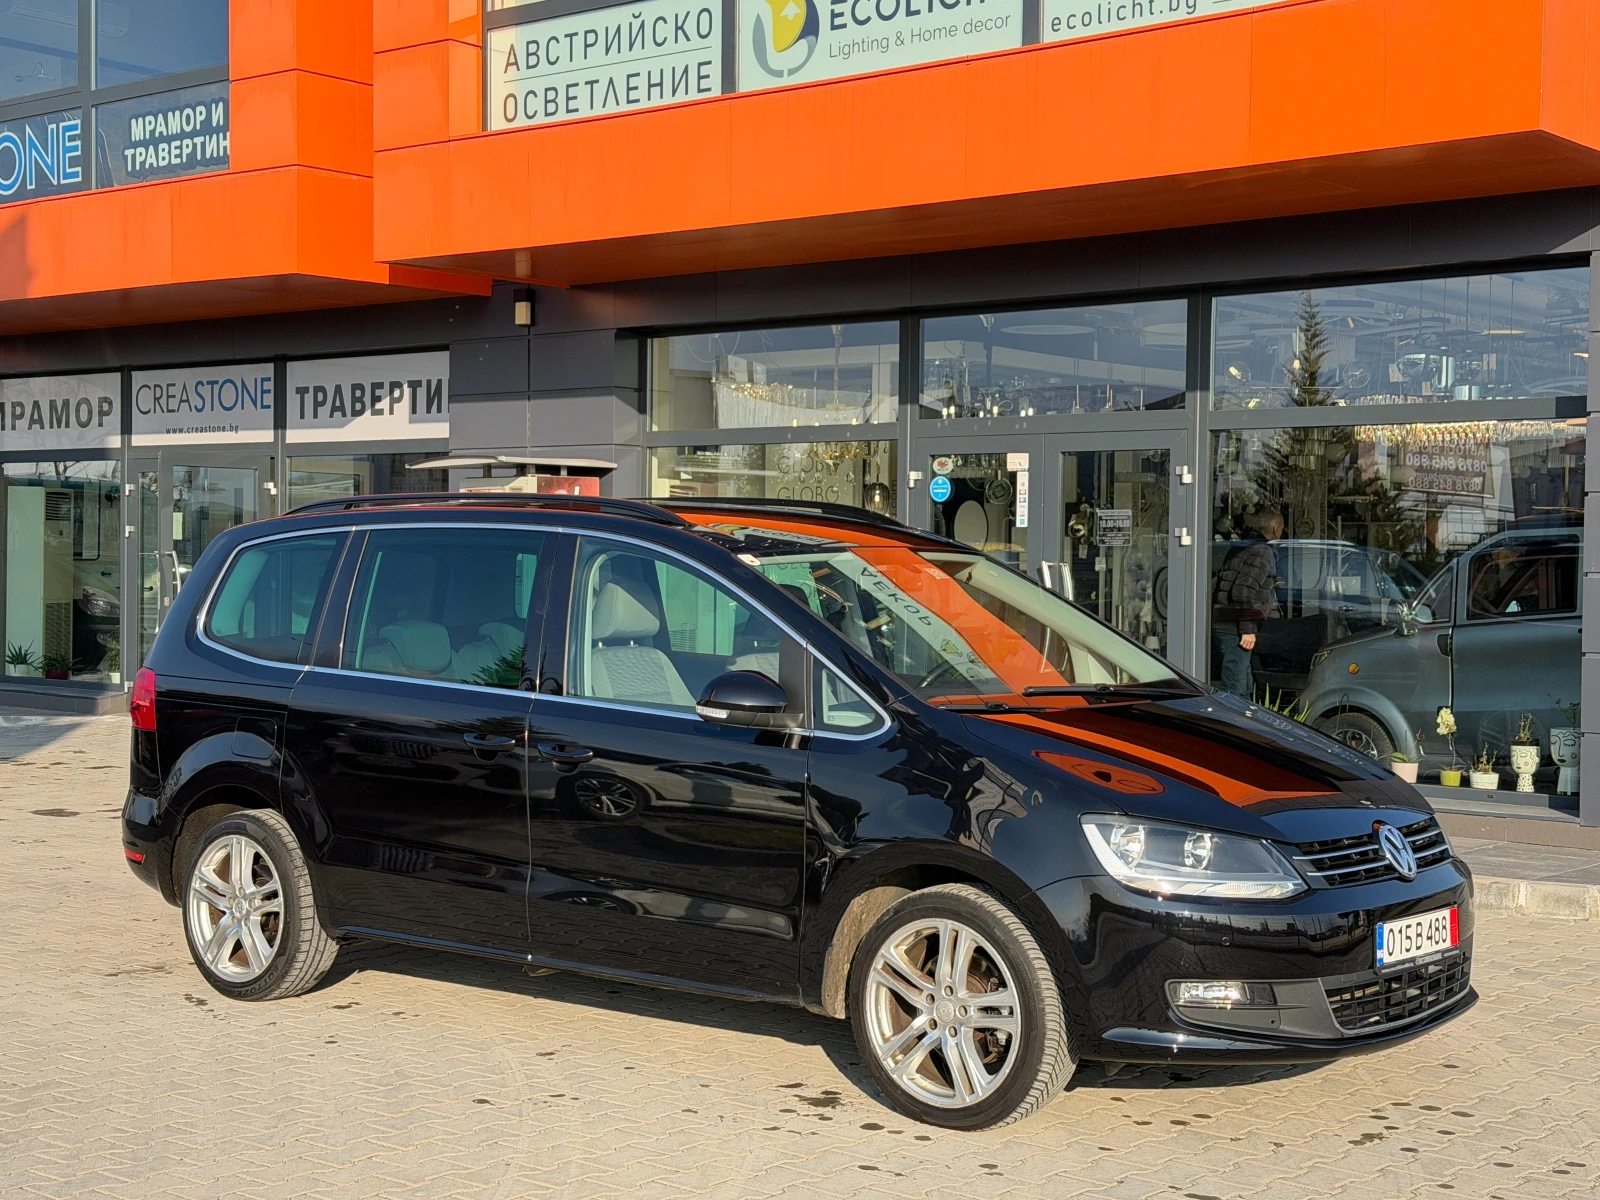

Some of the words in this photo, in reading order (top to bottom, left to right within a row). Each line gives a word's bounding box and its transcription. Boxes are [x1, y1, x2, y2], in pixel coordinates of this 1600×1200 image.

[830, 0, 985, 31] ECOL
[503, 7, 713, 74] АВСТРИЙСКО
[828, 36, 890, 60] Lighting
[894, 30, 906, 47] &
[910, 24, 958, 45] Home
[963, 14, 1011, 35] decor
[503, 60, 713, 123] ОСВЕТЛЕНИЕ
[130, 105, 207, 142] МРАМОР
[211, 101, 224, 128] И
[124, 131, 230, 173] ТРАВЕРТИН
[0, 396, 114, 431] РАМОР
[135, 376, 272, 415] CREASTONE
[295, 378, 450, 420] ТРАВЕРТИ
[165, 423, 240, 435] www.creastone.bg
[777, 455, 829, 474] GLOB
